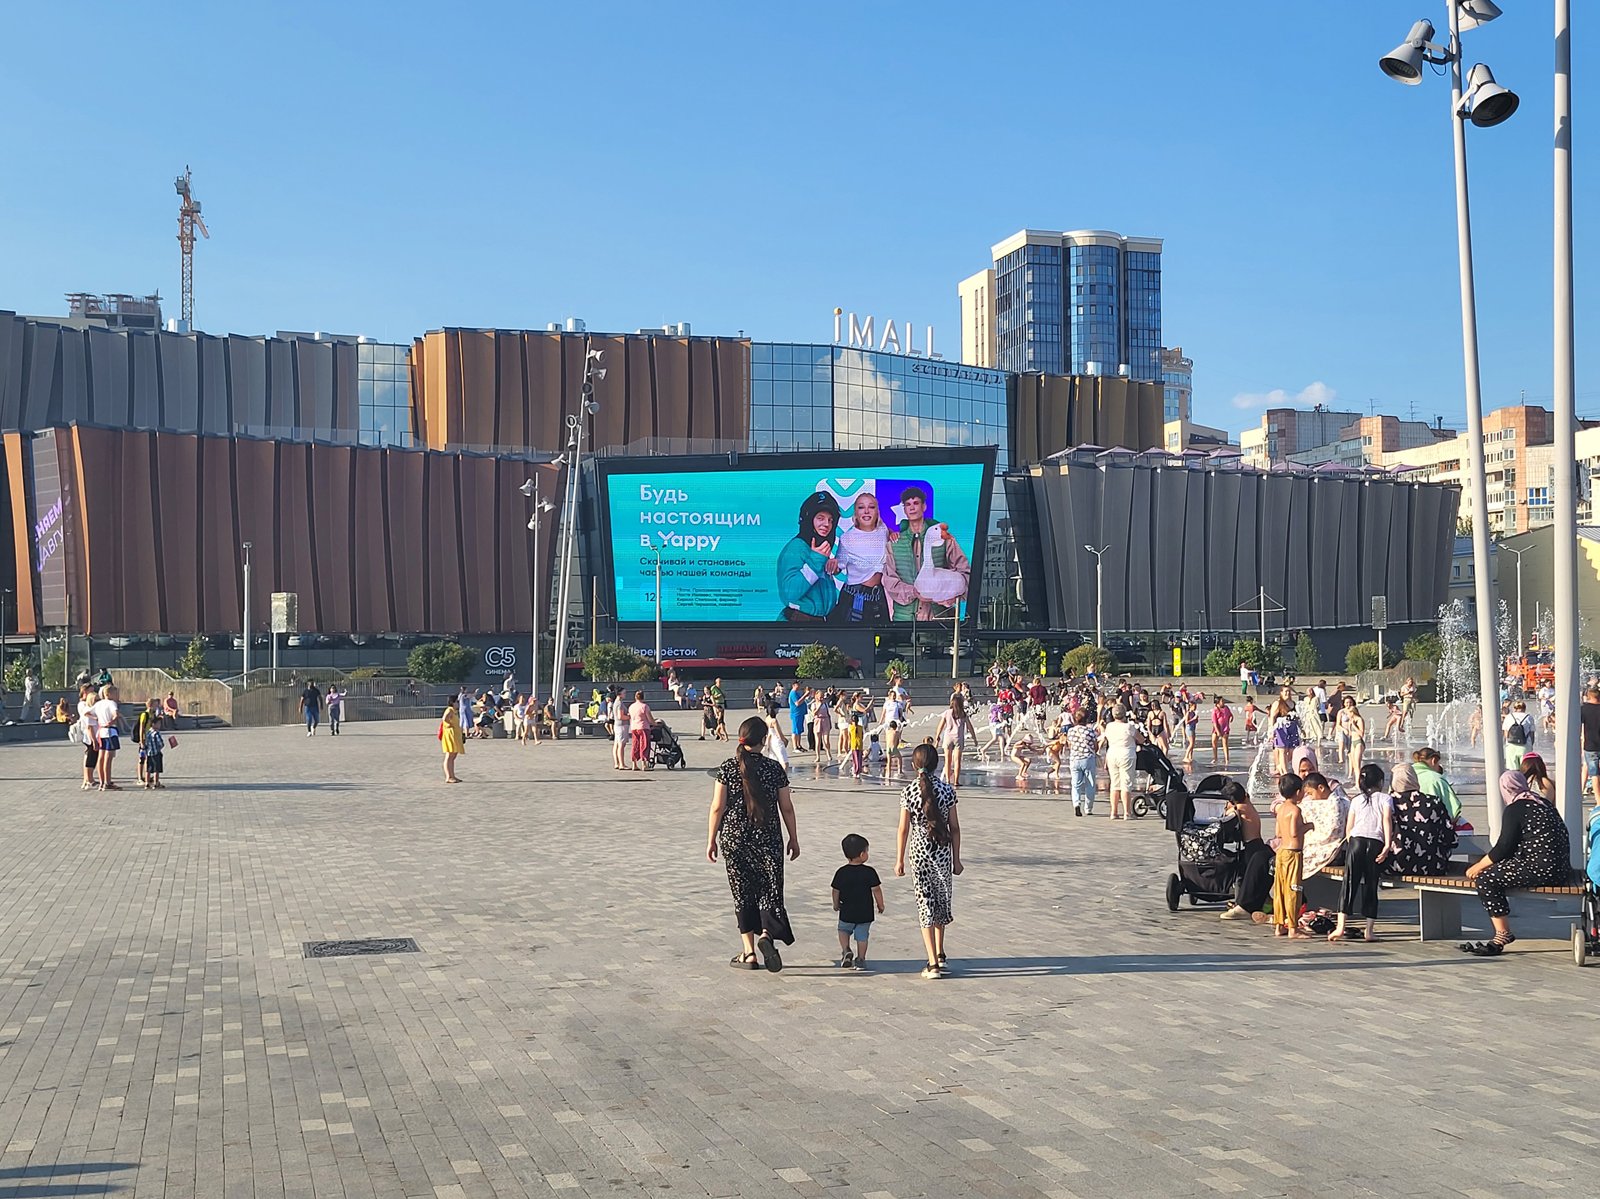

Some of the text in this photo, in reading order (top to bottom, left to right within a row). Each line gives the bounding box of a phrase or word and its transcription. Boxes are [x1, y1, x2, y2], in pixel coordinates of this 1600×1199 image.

[640, 484, 688, 505] Будь
[640, 511, 761, 528] настоящим
[640, 530, 721, 552] в Yappy
[640, 557, 687, 566] Скачивай
[640, 568, 752, 578] часью нашей команды
[645, 592, 662, 602] 12
